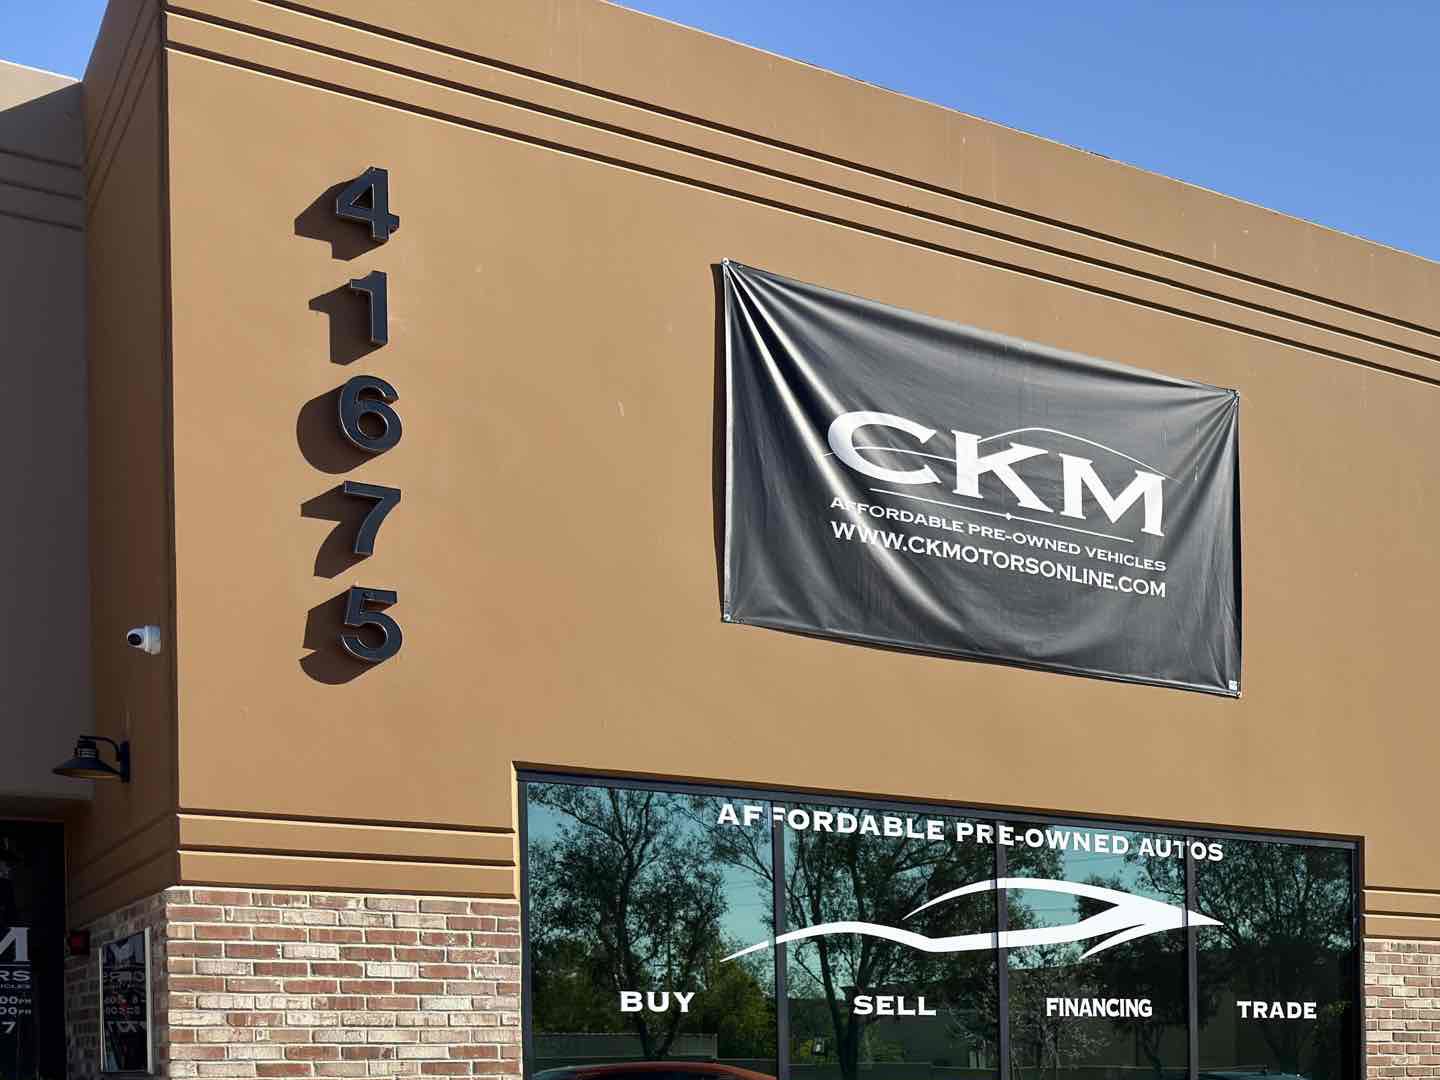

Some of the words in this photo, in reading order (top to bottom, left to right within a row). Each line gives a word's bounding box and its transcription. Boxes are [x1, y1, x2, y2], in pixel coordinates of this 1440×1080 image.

[336, 166, 403, 663] 41675
[827, 410, 1165, 536] CKM
[830, 496, 965, 533] AFFORDABLE
[968, 524, 1081, 555] PRE-OWNED
[1085, 546, 1167, 572] VEHICLES
[831, 520, 1166, 598] WWW.CKMOTORSONLINE.COM
[717, 803, 946, 841] AFFORDABLE
[956, 822, 1130, 854] PRE-OWNED
[1138, 837, 1224, 862] AUTOS
[620, 990, 695, 1013] BUY
[853, 995, 937, 1016] SELL
[1046, 997, 1153, 1018] FINANCING
[1236, 1001, 1317, 1019] TRADE
